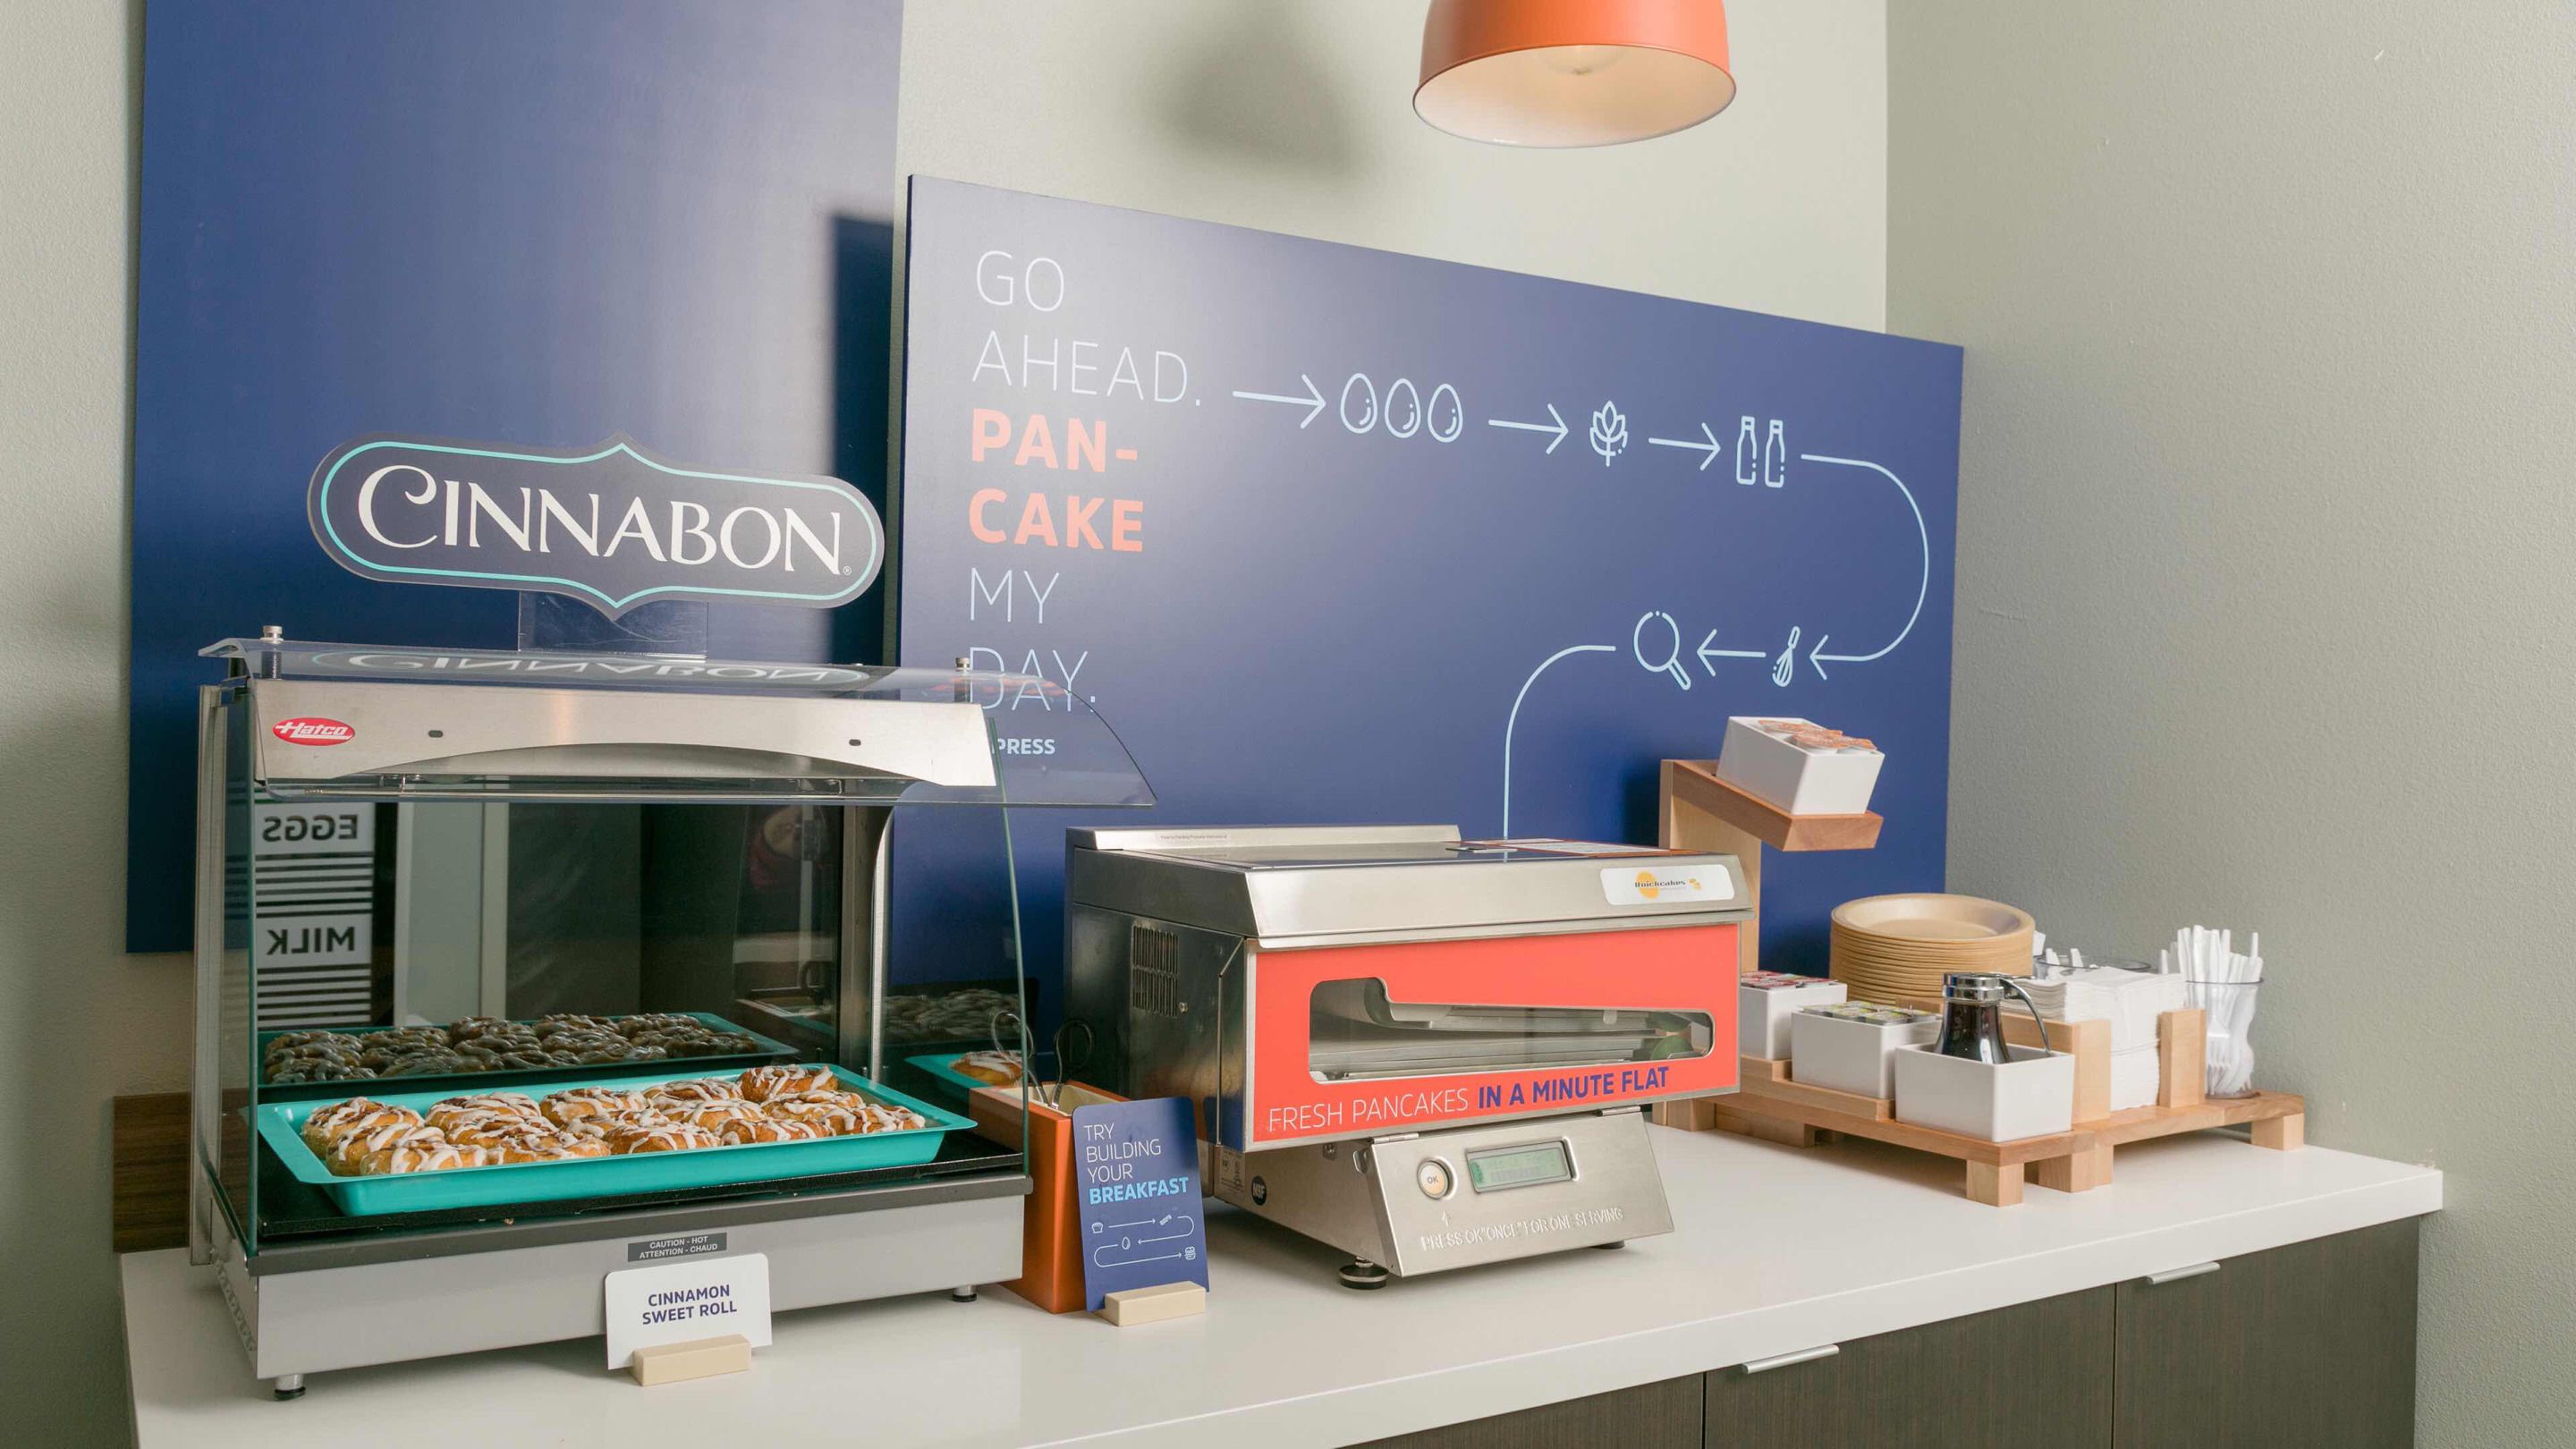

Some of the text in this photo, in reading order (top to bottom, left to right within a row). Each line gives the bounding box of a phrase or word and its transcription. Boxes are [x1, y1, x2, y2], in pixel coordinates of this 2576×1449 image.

[975, 250, 1065, 313] GO
[971, 330, 1201, 407] AHEAD.
[971, 408, 1138, 473] PAN-
[969, 488, 1144, 552] CAKE
[969, 566, 1060, 624] MY
[970, 647, 1096, 712] DAY.
[274, 721, 353, 741] Hatco
[1268, 1065, 1670, 1133] FRESH PANCAKES IN A MINUTE FLAT
[1084, 1123, 1114, 1141] TRY
[1086, 1139, 1162, 1163] BUILDING
[1088, 1164, 1133, 1183] YOUR
[1427, 1175, 1439, 1184] OK
[1089, 1177, 1189, 1206] BREAKFAST
[639, 1249, 683, 1258] ATTENTION
[690, 1243, 717, 1252] CHAUD
[649, 1239, 685, 1249] CAUTION
[691, 1236, 708, 1244] HOT
[648, 1284, 730, 1307] CINNAMON
[642, 1301, 737, 1325] SWEET ROLL
